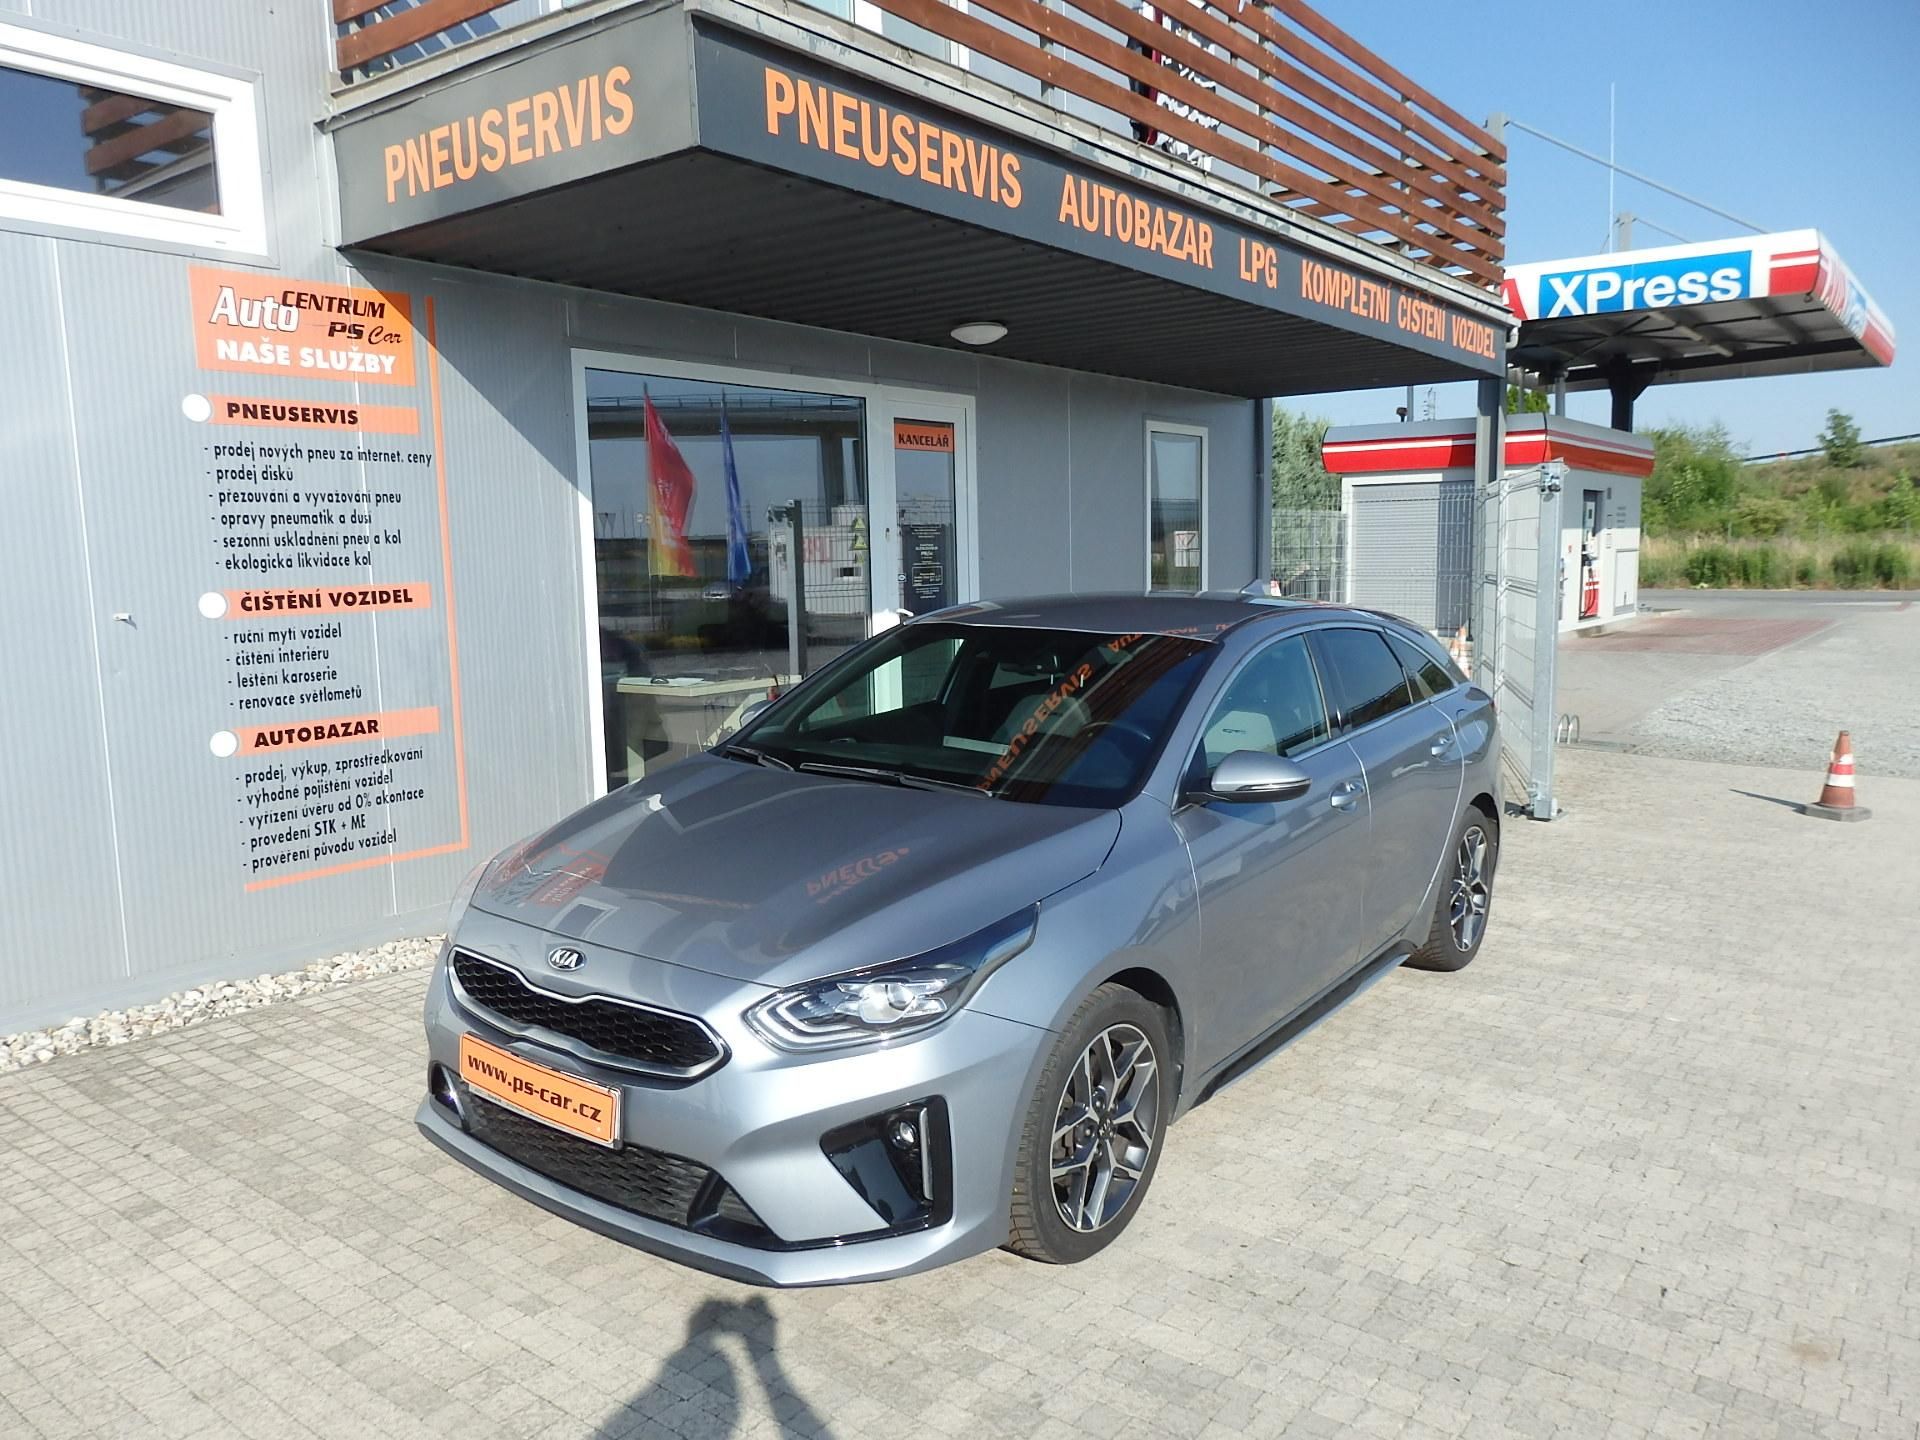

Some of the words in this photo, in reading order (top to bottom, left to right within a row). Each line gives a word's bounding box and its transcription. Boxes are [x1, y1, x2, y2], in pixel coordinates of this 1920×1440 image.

[384, 65, 634, 203] PNEUSERVIS
[765, 67, 1022, 209] PNEUSERVIS
[1058, 174, 1214, 270] AUTOBAZAR
[1239, 238, 1278, 289] LPG
[1301, 259, 1393, 324] KOMPLETNÍ
[1397, 287, 1446, 342] ČIŠTĚNÍ
[1452, 314, 1496, 359] VOZIDEL
[282, 290, 386, 319] CENTRUM
[1546, 267, 1743, 318] XPress
[209, 285, 299, 332] Auto
[328, 322, 365, 340] PS
[367, 325, 403, 345] Car
[216, 336, 291, 366] NAŠE
[300, 346, 397, 375] SLUŽBY
[227, 402, 359, 425] PNEUSERVIS
[898, 433, 950, 448] KANCELÁŘ
[214, 441, 255, 461] prodej
[259, 443, 303, 462] nových
[307, 448, 336, 463] pneu
[340, 450, 353, 460] za
[407, 452, 432, 467] ceny
[216, 465, 257, 484] prodej
[261, 465, 294, 481] disků
[218, 489, 288, 506] přezouvání
[293, 493, 300, 503] a
[305, 490, 371, 506] vyvažování
[375, 492, 401, 506] pneu
[221, 514, 265, 528] opravy
[270, 509, 334, 527] pneumatik
[339, 515, 346, 524] a
[223, 532, 270, 548] sezónní
[274, 531, 339, 547] uskladnění
[343, 534, 370, 548] pneu
[374, 534, 381, 545] a
[384, 529, 401, 544] kol
[225, 553, 293, 573] ekologická
[298, 552, 350, 568] likvidace
[354, 551, 372, 566] kol
[240, 589, 322, 612] ČIŠTĚNÍ
[328, 588, 413, 606] VOZIDEL
[233, 628, 264, 644] ruční
[300, 622, 342, 639] vozidel
[235, 649, 275, 666] čištění
[279, 645, 329, 663] interiéru
[237, 671, 278, 688] leštění
[282, 665, 337, 684] karoserie
[240, 694, 295, 710] renovace
[300, 685, 362, 704] světlometů
[254, 719, 380, 748] AUTOBAZAR
[245, 763, 287, 787] prodej,
[291, 760, 331, 780] výkup,
[335, 746, 423, 771] zprostředkování
[247, 785, 299, 808] výhodné
[304, 778, 351, 798] pojištění
[355, 769, 393, 789] vozidel
[338, 799, 352, 811] od
[355, 793, 372, 809] 0%
[375, 788, 424, 806] akontace
[250, 824, 311, 852] provedení
[314, 819, 337, 837] STK
[351, 814, 366, 831] ME
[252, 848, 310, 873] prověření
[314, 837, 355, 861] původu
[358, 828, 397, 848] vozidel
[551, 949, 577, 968] KIA
[467, 1054, 602, 1123] www.ps-car.cz
